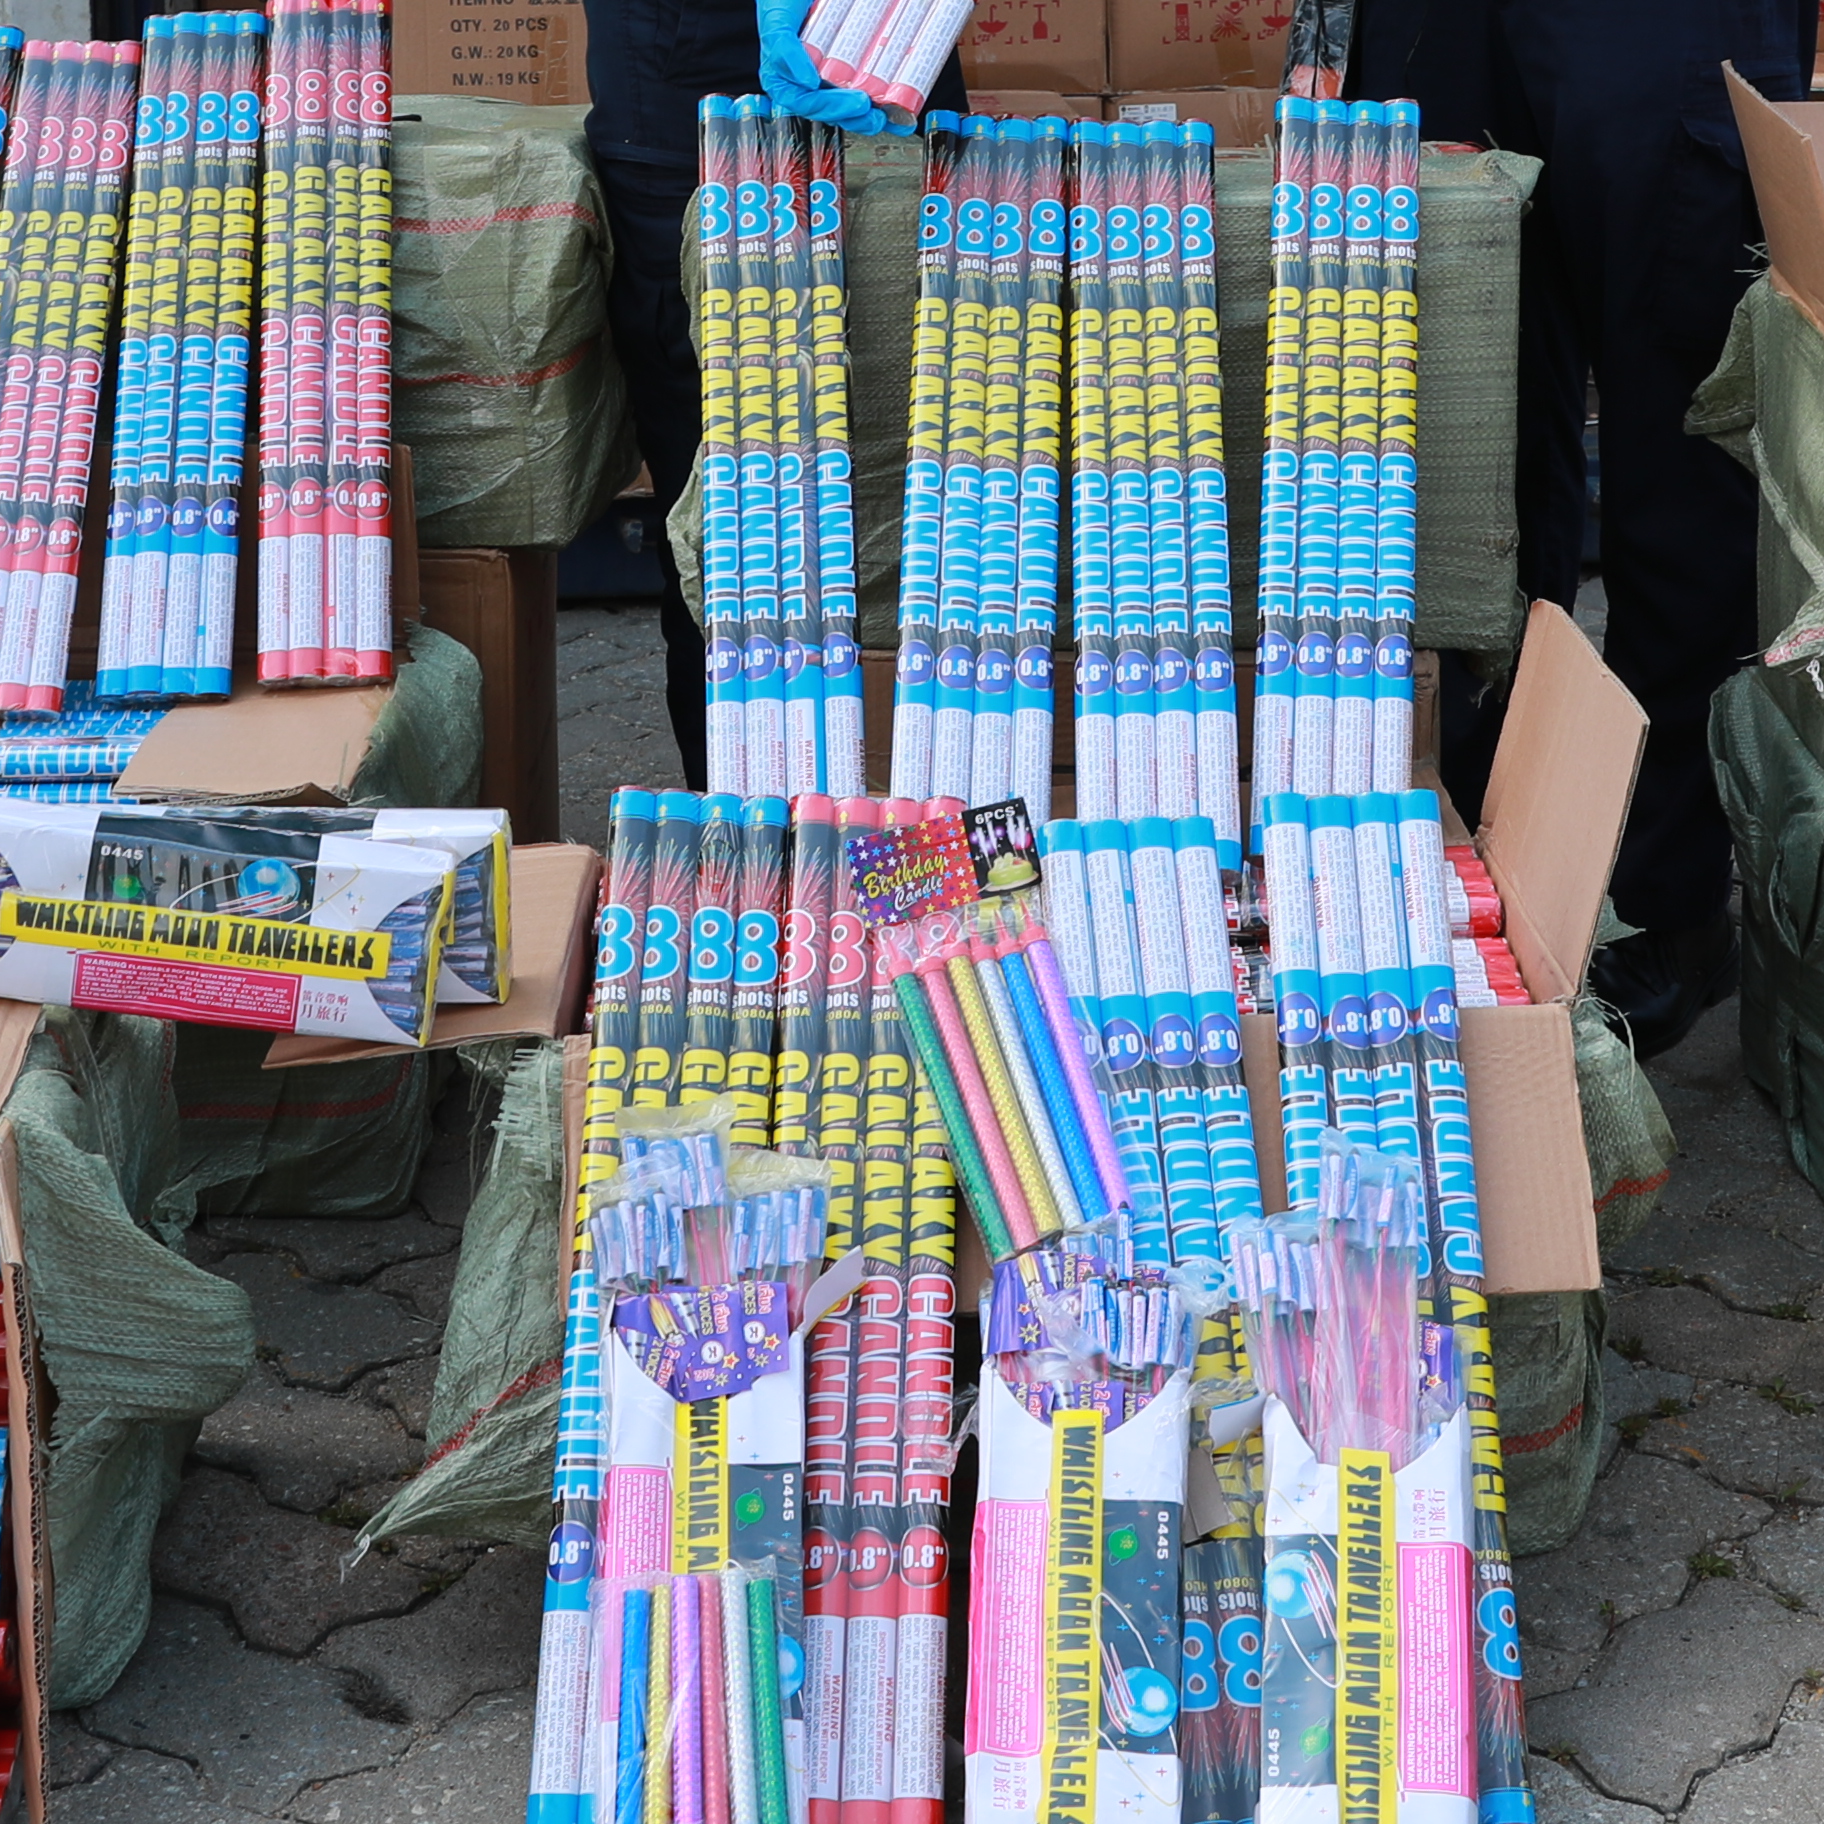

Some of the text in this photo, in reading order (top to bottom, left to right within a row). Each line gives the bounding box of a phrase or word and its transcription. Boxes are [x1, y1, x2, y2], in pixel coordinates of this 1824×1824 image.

[358, 70, 393, 126] 8
[1382, 184, 1419, 243] 8
[358, 167, 393, 313] GALAXY
[356, 315, 392, 469] CANDLE
[1380, 288, 1419, 451] GALAXY
[1376, 452, 1417, 625] CANDLE
[974, 805, 1017, 826] 6PCS
[100, 843, 144, 862] 0445
[862, 853, 946, 899] Birthday
[893, 875, 944, 911] Candle
[83, 956, 127, 969] WARNING
[97, 939, 287, 972] WITH REPORT
[225, 921, 375, 971] TRAVELLERS
[698, 1299, 715, 1336] VOICES
[782, 1472, 796, 1522] 0445
[1157, 1511, 1169, 1561] 0445
[1345, 1464, 1383, 1624] TRAVELLERS
[1045, 1518, 1058, 1736] WITH REPORT
[1383, 1560, 1395, 1769] WITH REPORT
[1267, 1728, 1281, 1778] 0445
